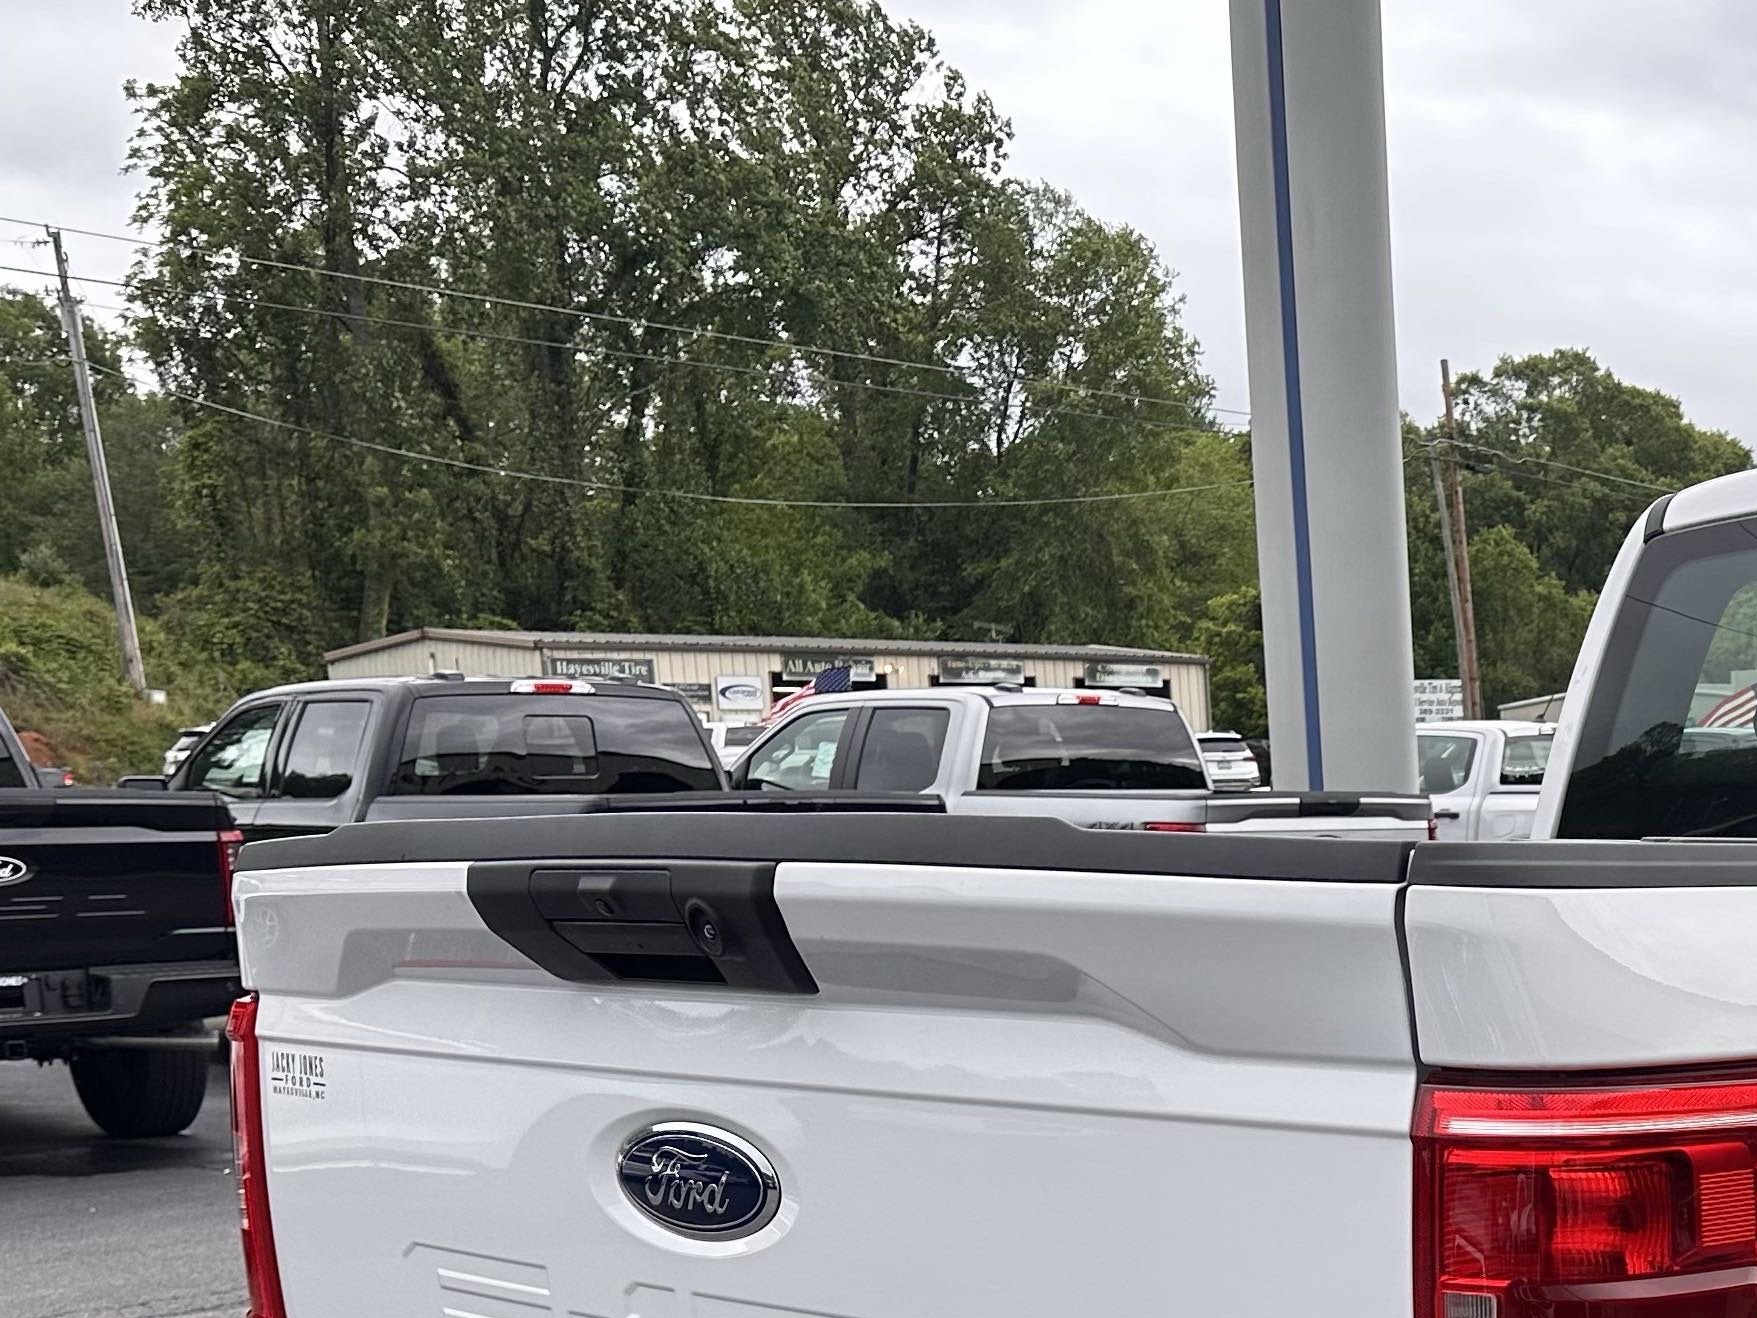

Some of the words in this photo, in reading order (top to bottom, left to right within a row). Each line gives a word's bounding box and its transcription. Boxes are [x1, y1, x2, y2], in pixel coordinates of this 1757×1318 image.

[556, 661, 620, 678] Hayesville
[621, 662, 648, 676] Tire
[786, 659, 803, 673] All
[806, 659, 832, 674] Auto
[271, 1051, 296, 1075] JACKY
[298, 1053, 324, 1078] JONES
[285, 1074, 311, 1088] FORD
[644, 1145, 731, 1215] Ford
